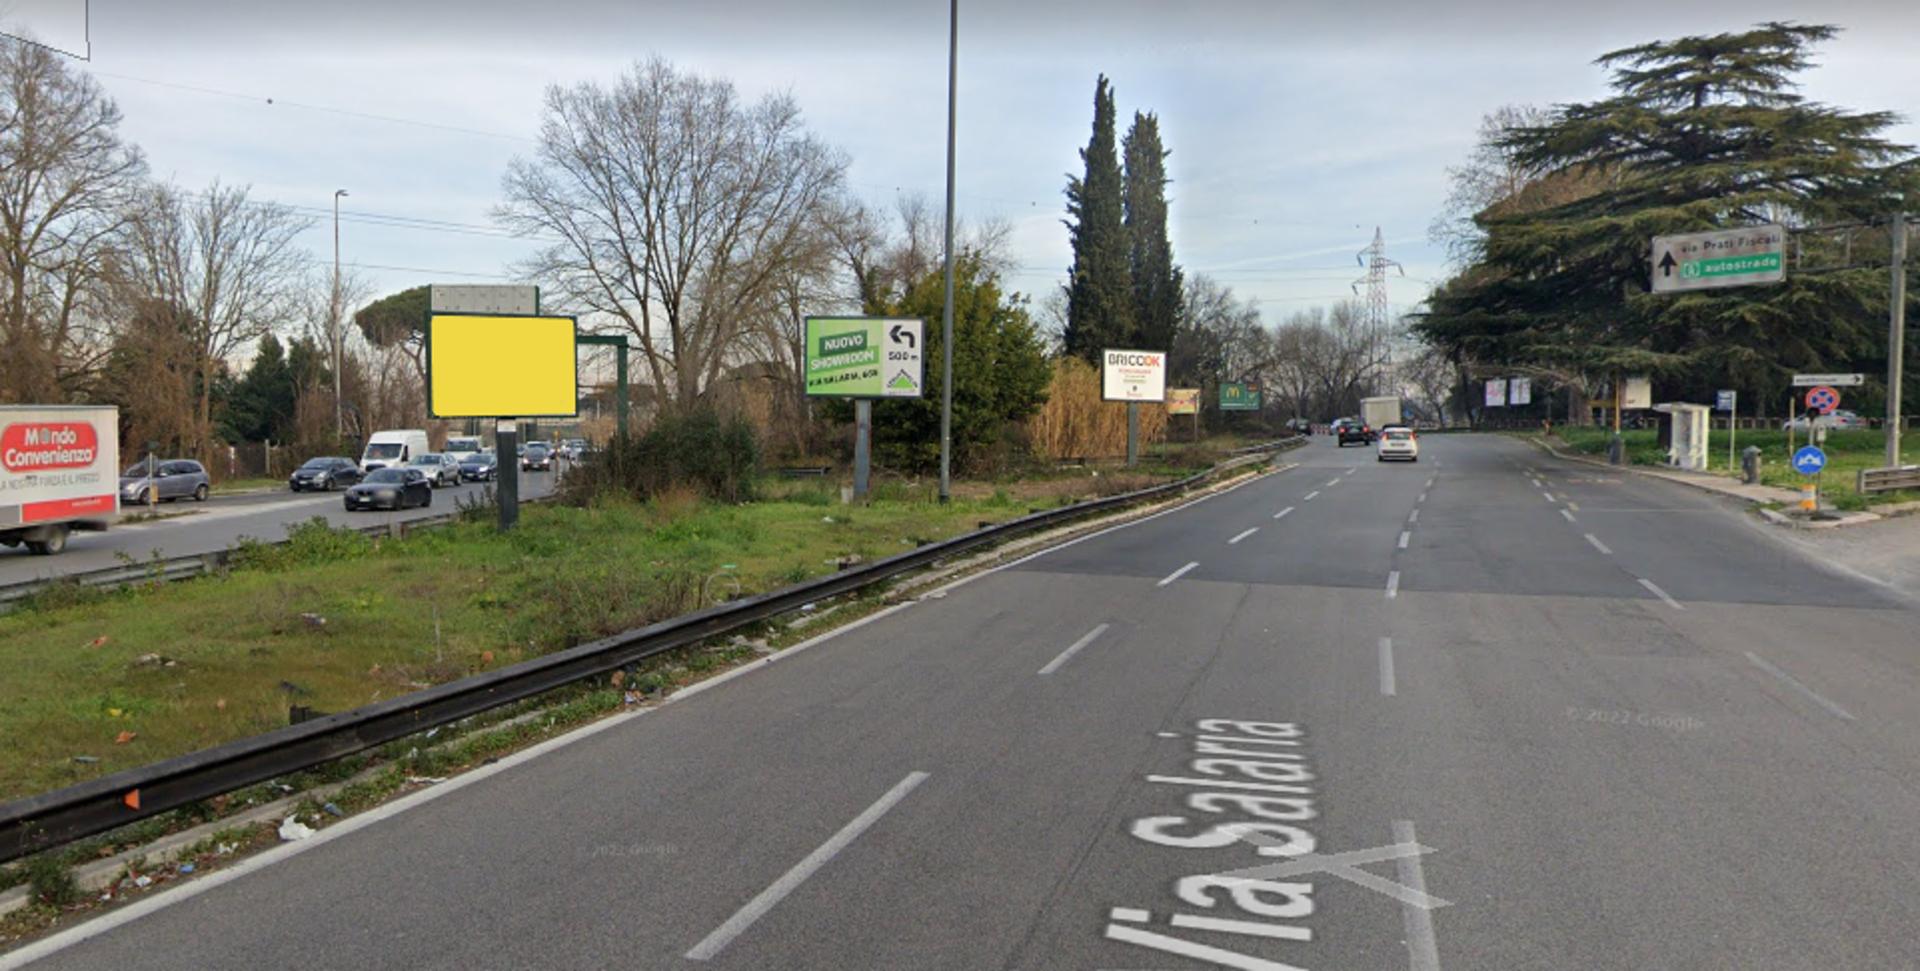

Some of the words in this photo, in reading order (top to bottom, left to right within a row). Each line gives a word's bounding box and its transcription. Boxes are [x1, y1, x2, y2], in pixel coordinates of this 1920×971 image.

[1703, 239, 1733, 251] Prati
[1704, 256, 1777, 273] autostrade
[824, 335, 863, 351] NUOVO
[5, 445, 93, 467] Convenienza
